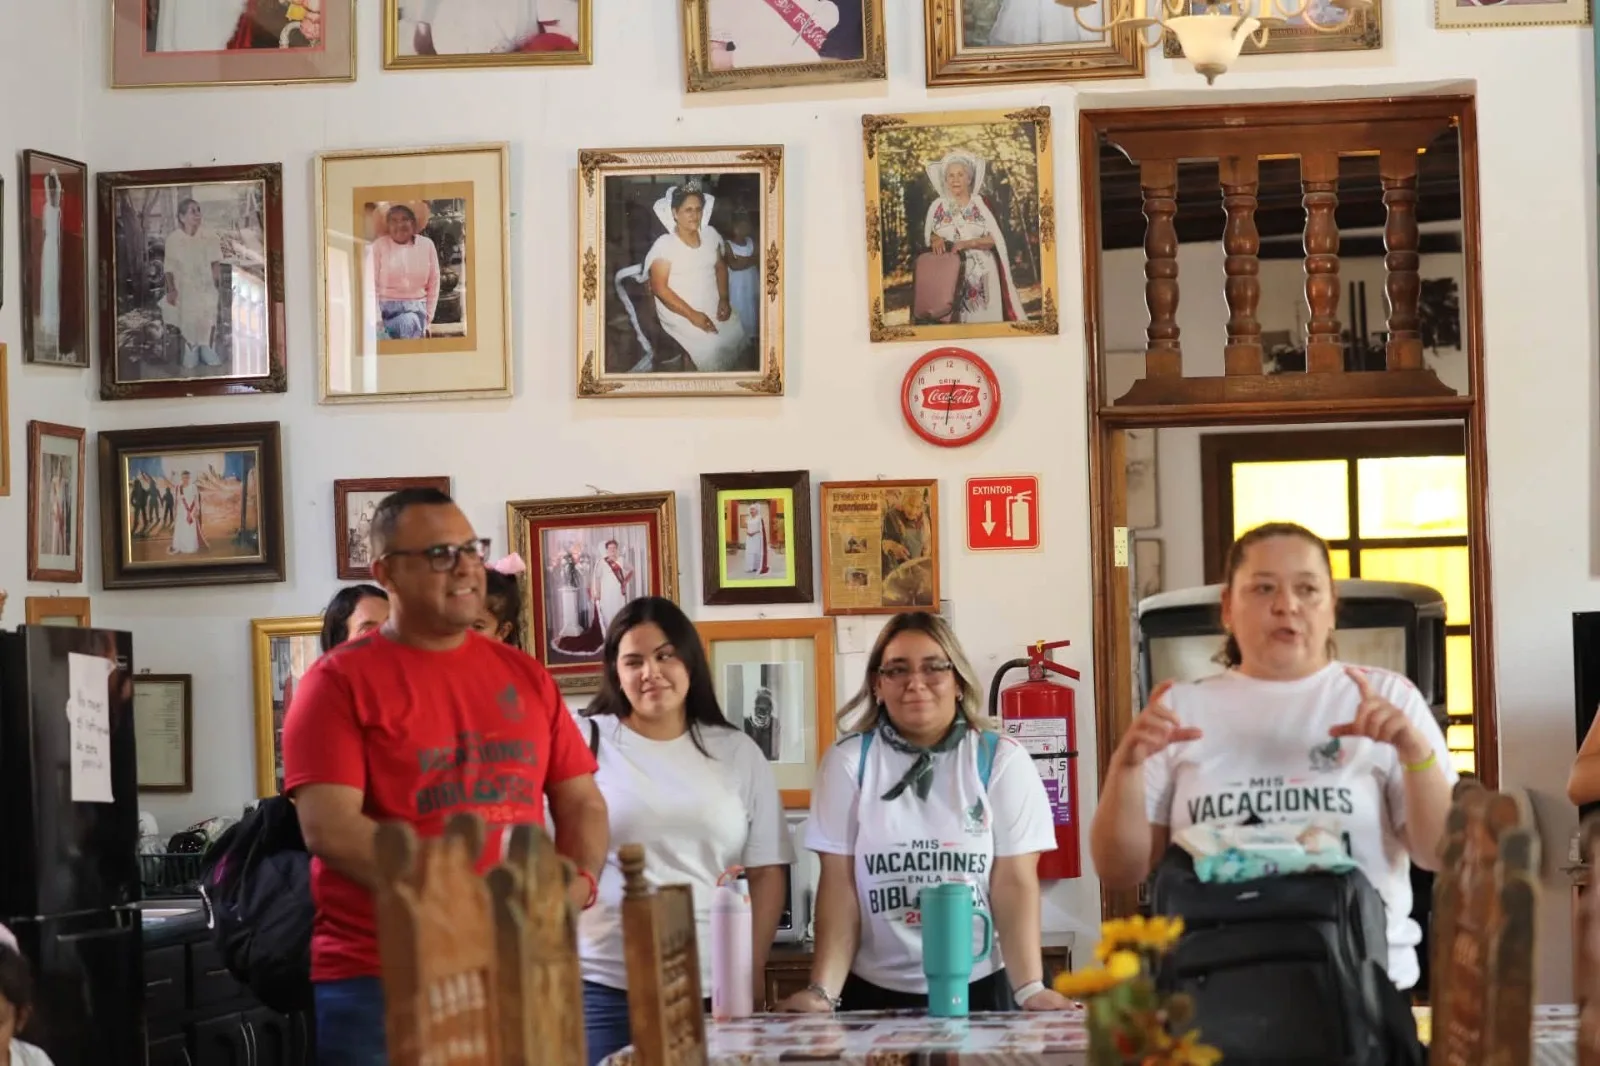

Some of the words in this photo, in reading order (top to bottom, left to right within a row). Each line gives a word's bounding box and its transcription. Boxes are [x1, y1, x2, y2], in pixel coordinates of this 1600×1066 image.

[929, 365, 935, 373] 11
[972, 485, 1013, 496] EXTINTOR
[1249, 775, 1284, 788] MIS
[1187, 787, 1353, 825] VACACIONES
[911, 839, 940, 850] MIS
[864, 851, 987, 876] VACACIONES
[908, 876, 923, 884] EN
[927, 875, 943, 883] LA
